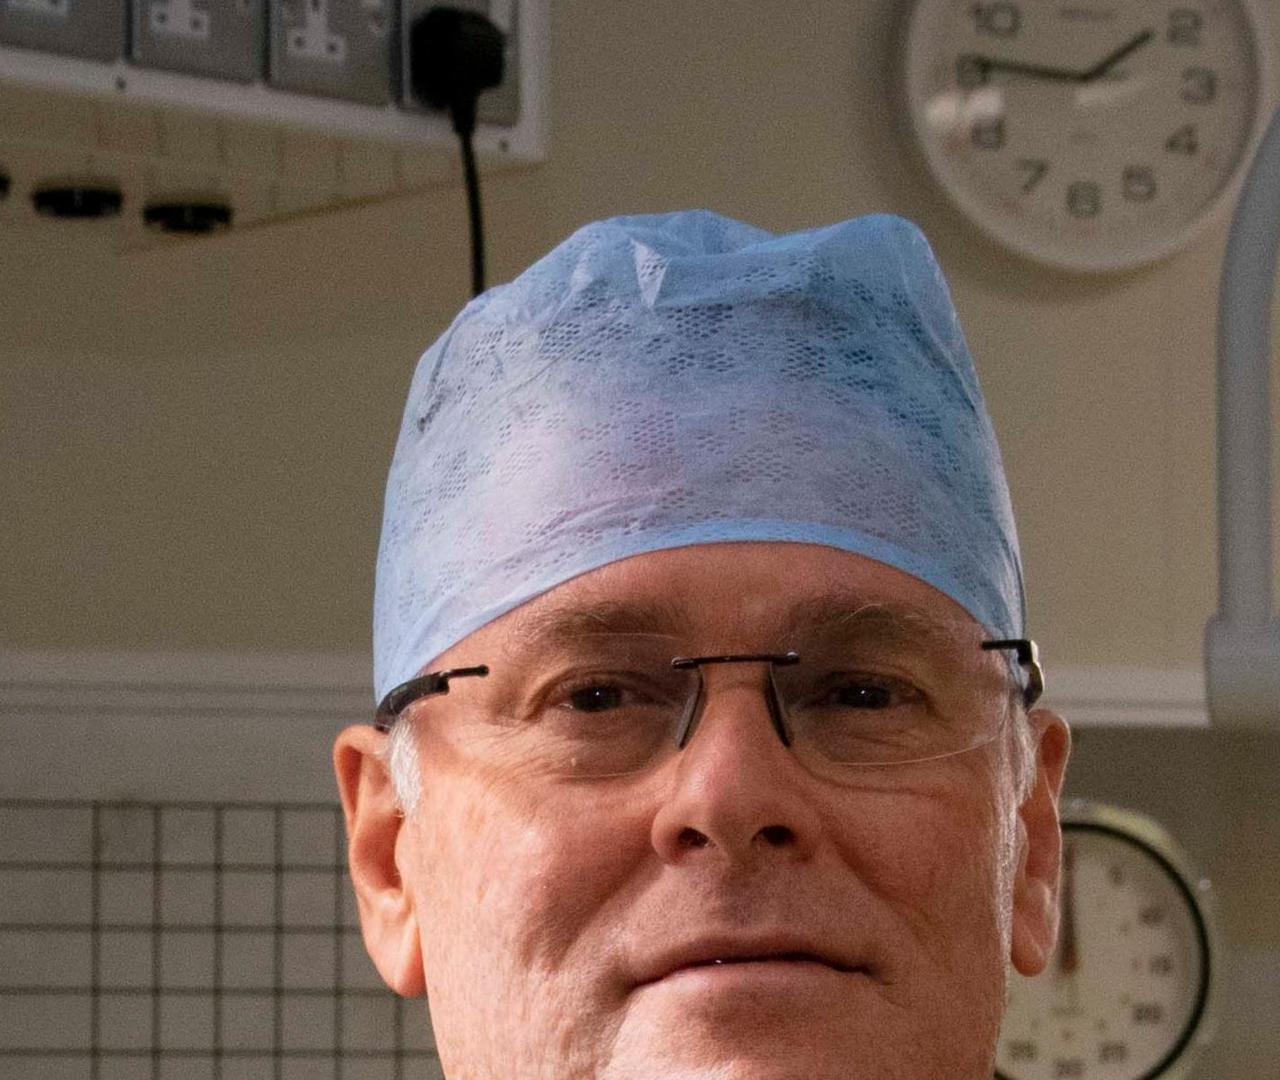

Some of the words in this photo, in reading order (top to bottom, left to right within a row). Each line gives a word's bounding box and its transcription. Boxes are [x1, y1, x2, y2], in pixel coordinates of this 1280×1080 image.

[969, 2, 1022, 39] 10
[1166, 8, 1204, 47] 2
[1181, 66, 1218, 106] 3
[1164, 123, 1200, 156] 4
[1016, 158, 1051, 194] 7
[1121, 165, 1157, 203] 5
[1065, 181, 1102, 219] 6
